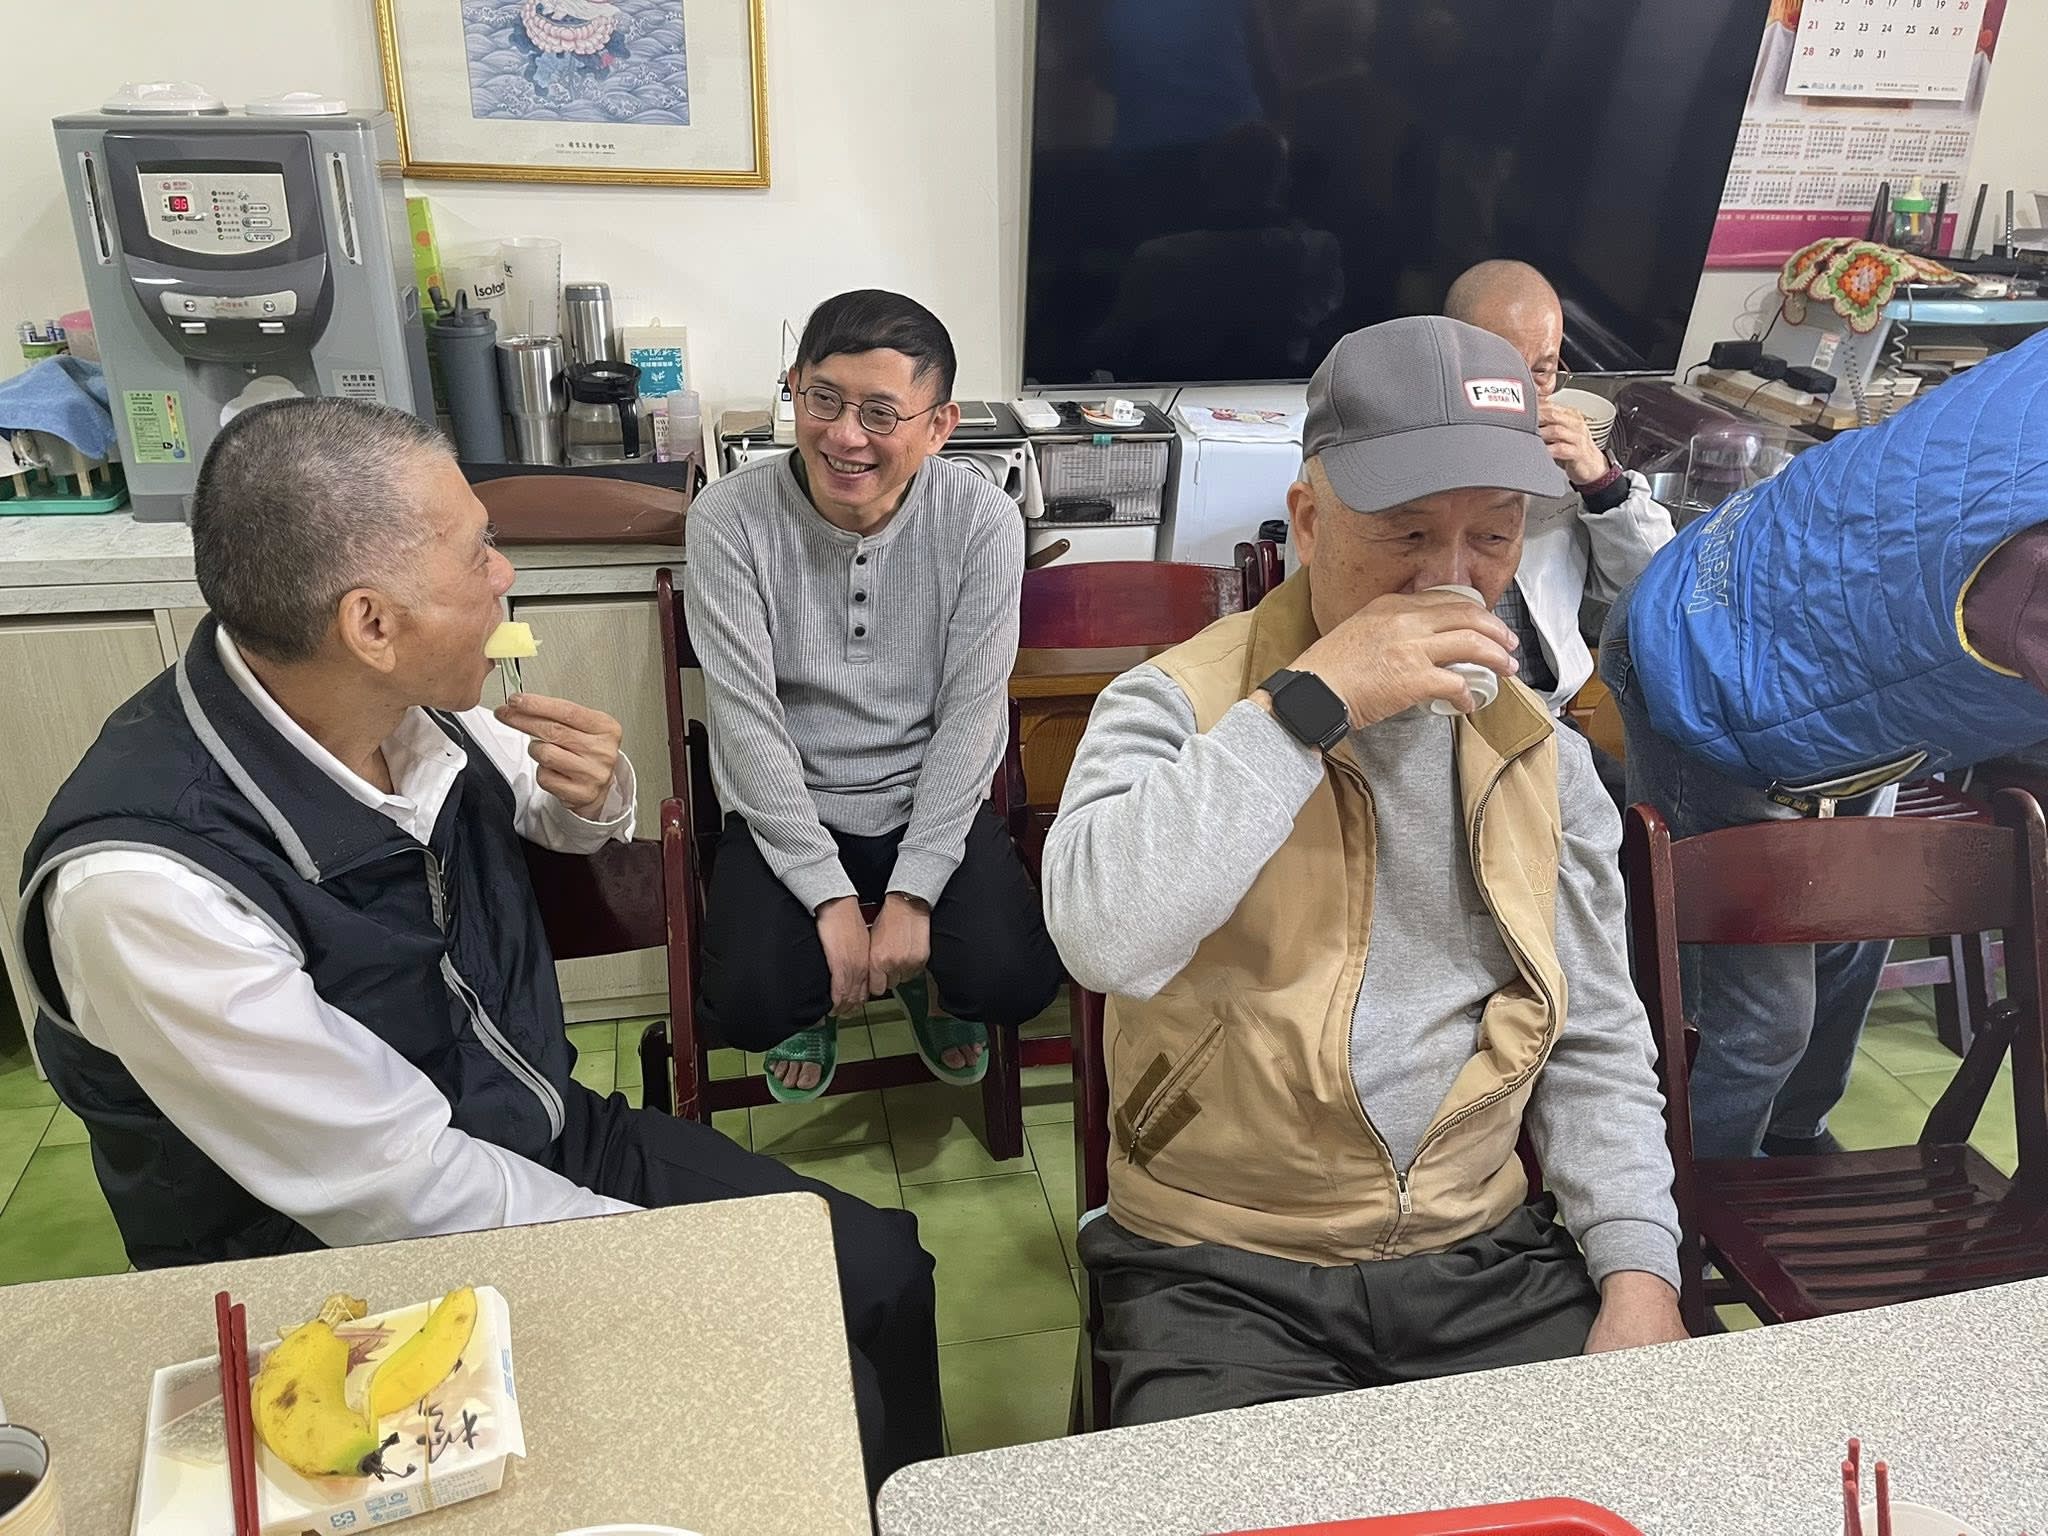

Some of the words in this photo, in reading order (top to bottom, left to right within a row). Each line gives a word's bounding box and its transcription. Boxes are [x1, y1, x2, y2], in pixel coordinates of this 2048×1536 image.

[1912, 0, 1922, 8] 18
[1936, 0, 1946, 9] 19
[1958, 1, 1969, 10] 20
[1807, 20, 1819, 30] 21
[1834, 22, 1846, 31] 22
[1858, 23, 1869, 32] 23
[1881, 24, 1893, 33] 24
[1905, 25, 1916, 34] 25
[1928, 26, 1940, 35] 26
[1952, 27, 1964, 36] 27
[1803, 47, 1815, 56] 28
[1829, 48, 1841, 57] 29
[1853, 49, 1864, 58] 30
[1876, 50, 1887, 59] 31
[174, 198, 187, 210] 96
